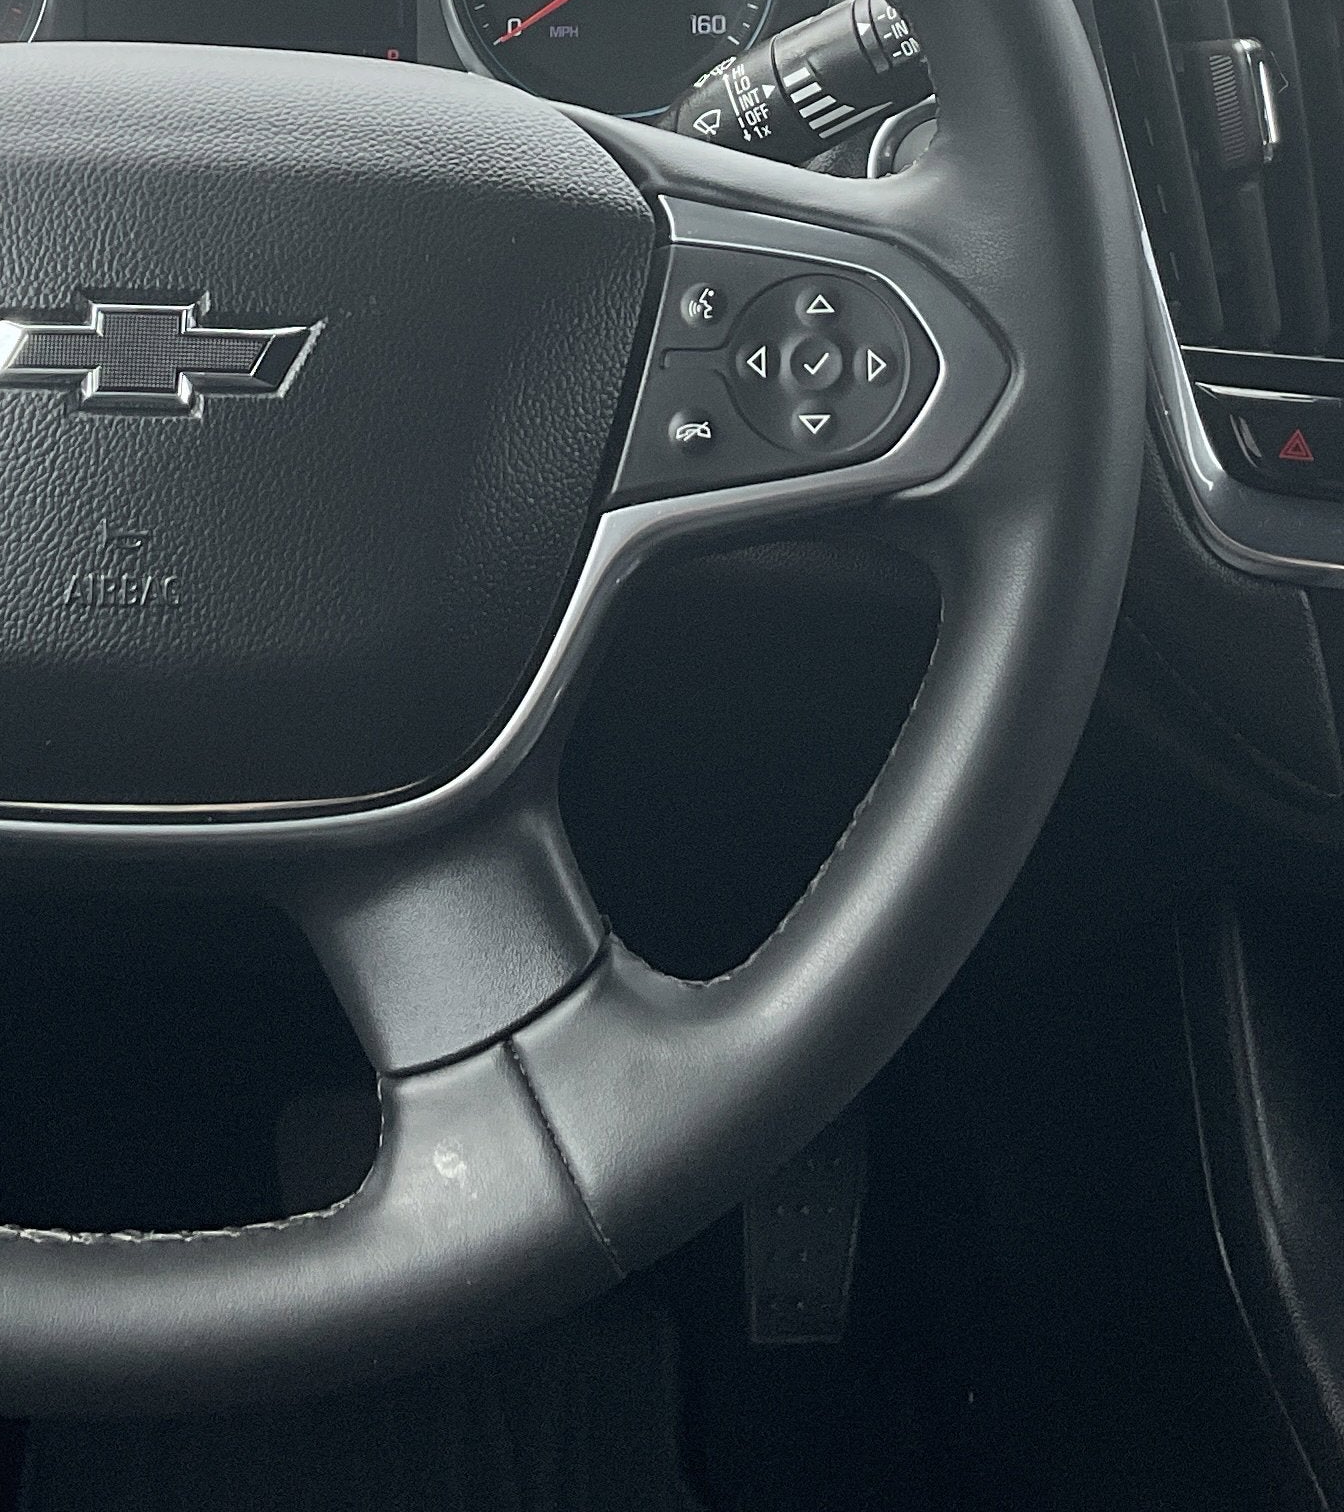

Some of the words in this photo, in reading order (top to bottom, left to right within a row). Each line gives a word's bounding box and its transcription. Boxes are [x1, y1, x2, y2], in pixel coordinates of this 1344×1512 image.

[506, 18, 522, 36] 0
[549, 26, 579, 38] MPH
[690, 14, 726, 35] 160
[732, 63, 745, 80] HI
[734, 75, 751, 95] LO
[738, 87, 760, 112] INT
[744, 102, 769, 126] OFF
[64, 573, 181, 606] AIRBAG
